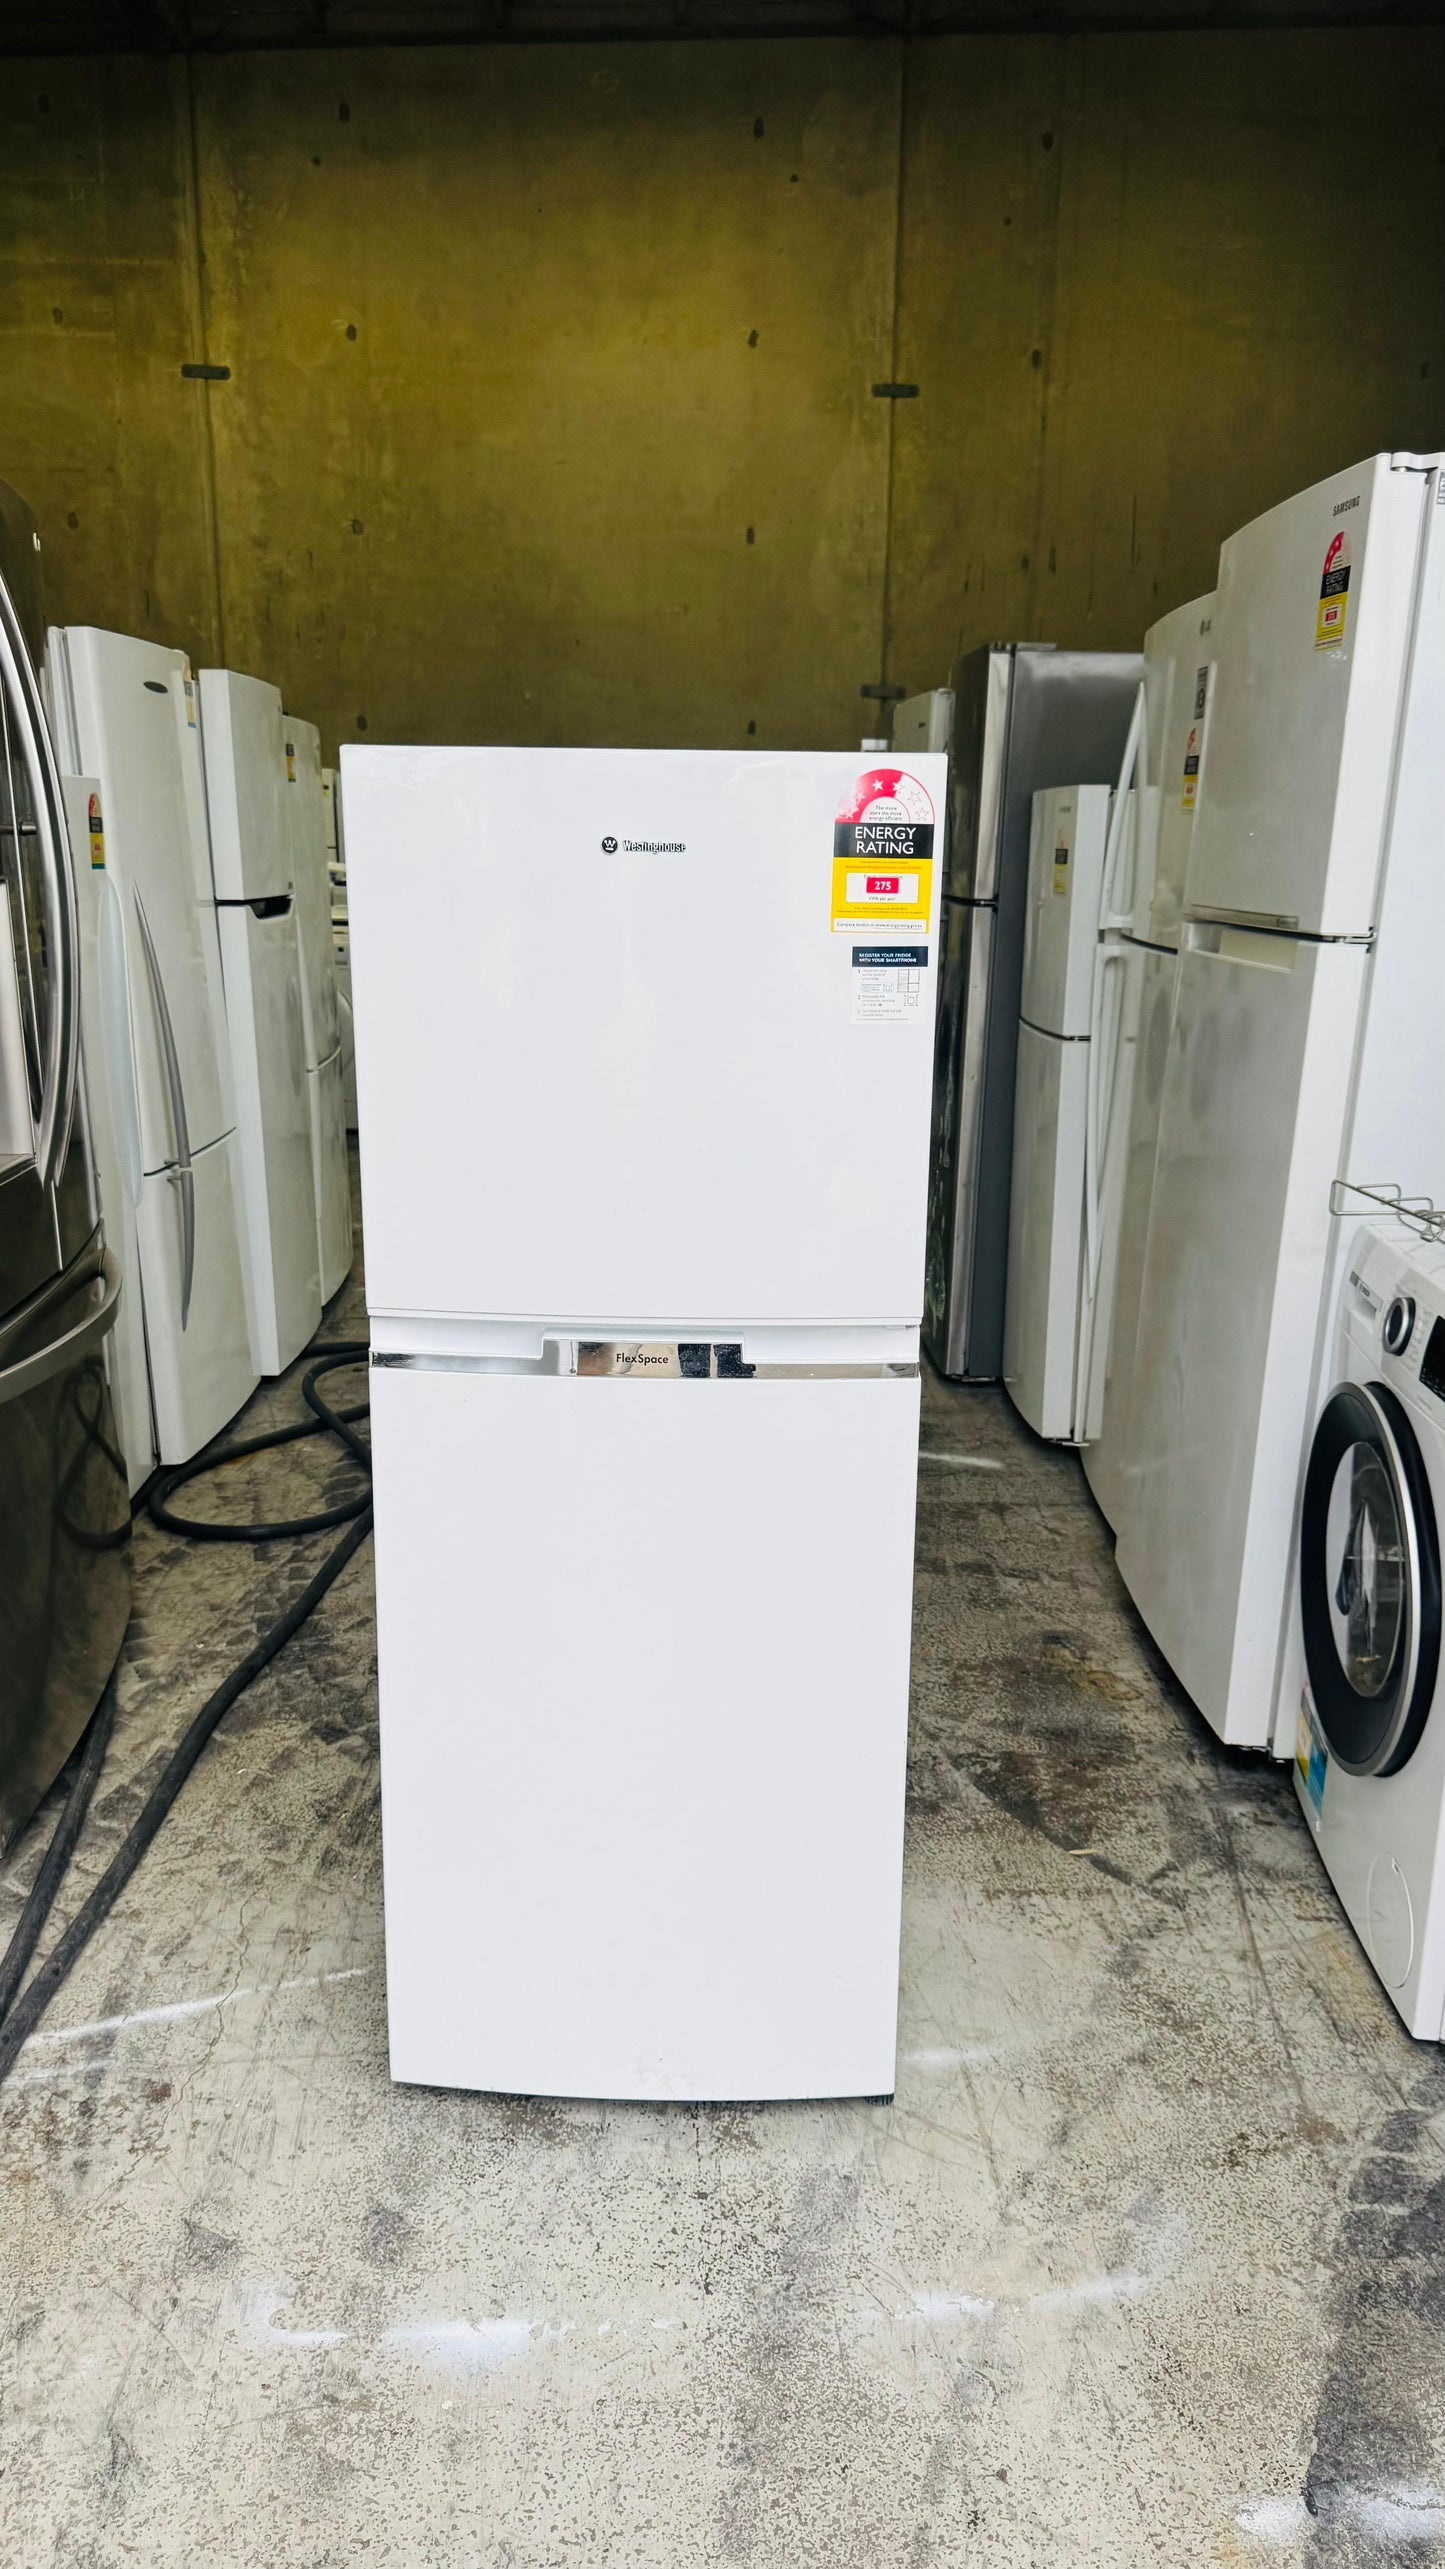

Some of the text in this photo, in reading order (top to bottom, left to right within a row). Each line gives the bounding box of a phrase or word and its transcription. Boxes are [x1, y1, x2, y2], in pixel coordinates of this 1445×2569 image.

[1333, 496, 1360, 516] SAMSUNG
[855, 827, 916, 839] ENERGY
[623, 840, 686, 855] Westinghouse
[856, 842, 914, 854] RATING
[874, 881, 891, 890] 275
[616, 1352, 668, 1366] FlexSpace
